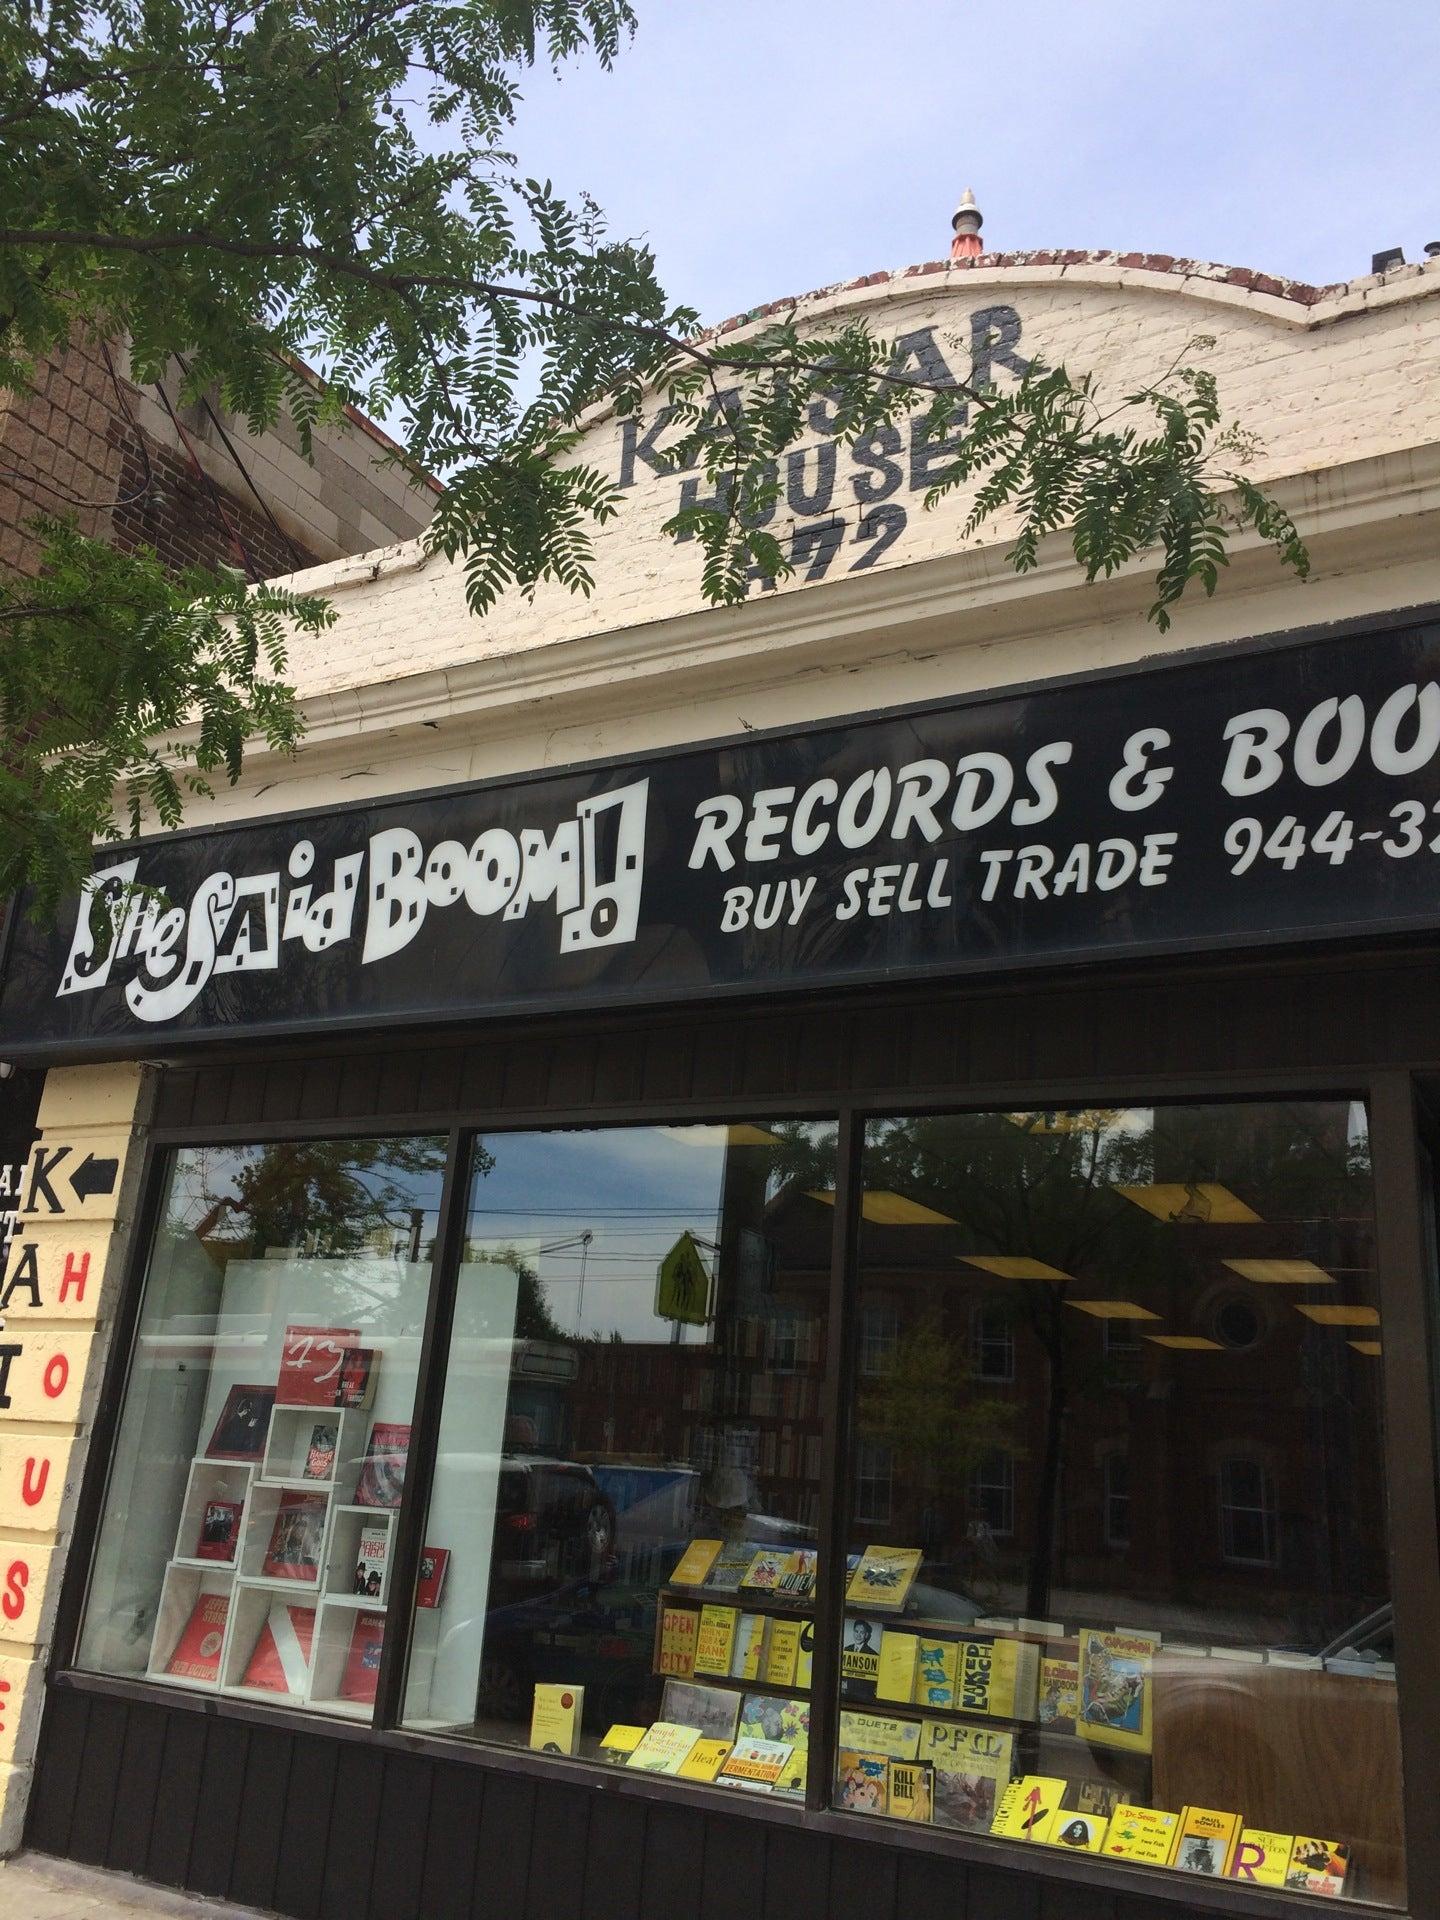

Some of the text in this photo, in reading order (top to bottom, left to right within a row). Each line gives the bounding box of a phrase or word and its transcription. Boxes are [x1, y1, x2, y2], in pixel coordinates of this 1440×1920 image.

[687, 740, 1073, 873] RECORDS
[1108, 727, 1174, 811] &
[720, 876, 815, 933] BUY
[835, 859, 953, 922] SELL
[979, 832, 1179, 901] TRADE
[664, 1614, 693, 1634] OPEN
[699, 1644, 727, 1659] BANK
[661, 1651, 693, 1674] CITY
[962, 1643, 980, 1709] NAKED
[975, 1646, 993, 1711] LUNCH
[857, 1717, 898, 1732] DUETS
[691, 1751, 718, 1767] Heat
[725, 1763, 777, 1780] FERMENTATION
[893, 1769, 915, 1785] KILL
[893, 1784, 914, 1800] BILL
[1194, 1820, 1225, 1829] BOWLES
[1201, 1816, 1220, 1824] PAUL
